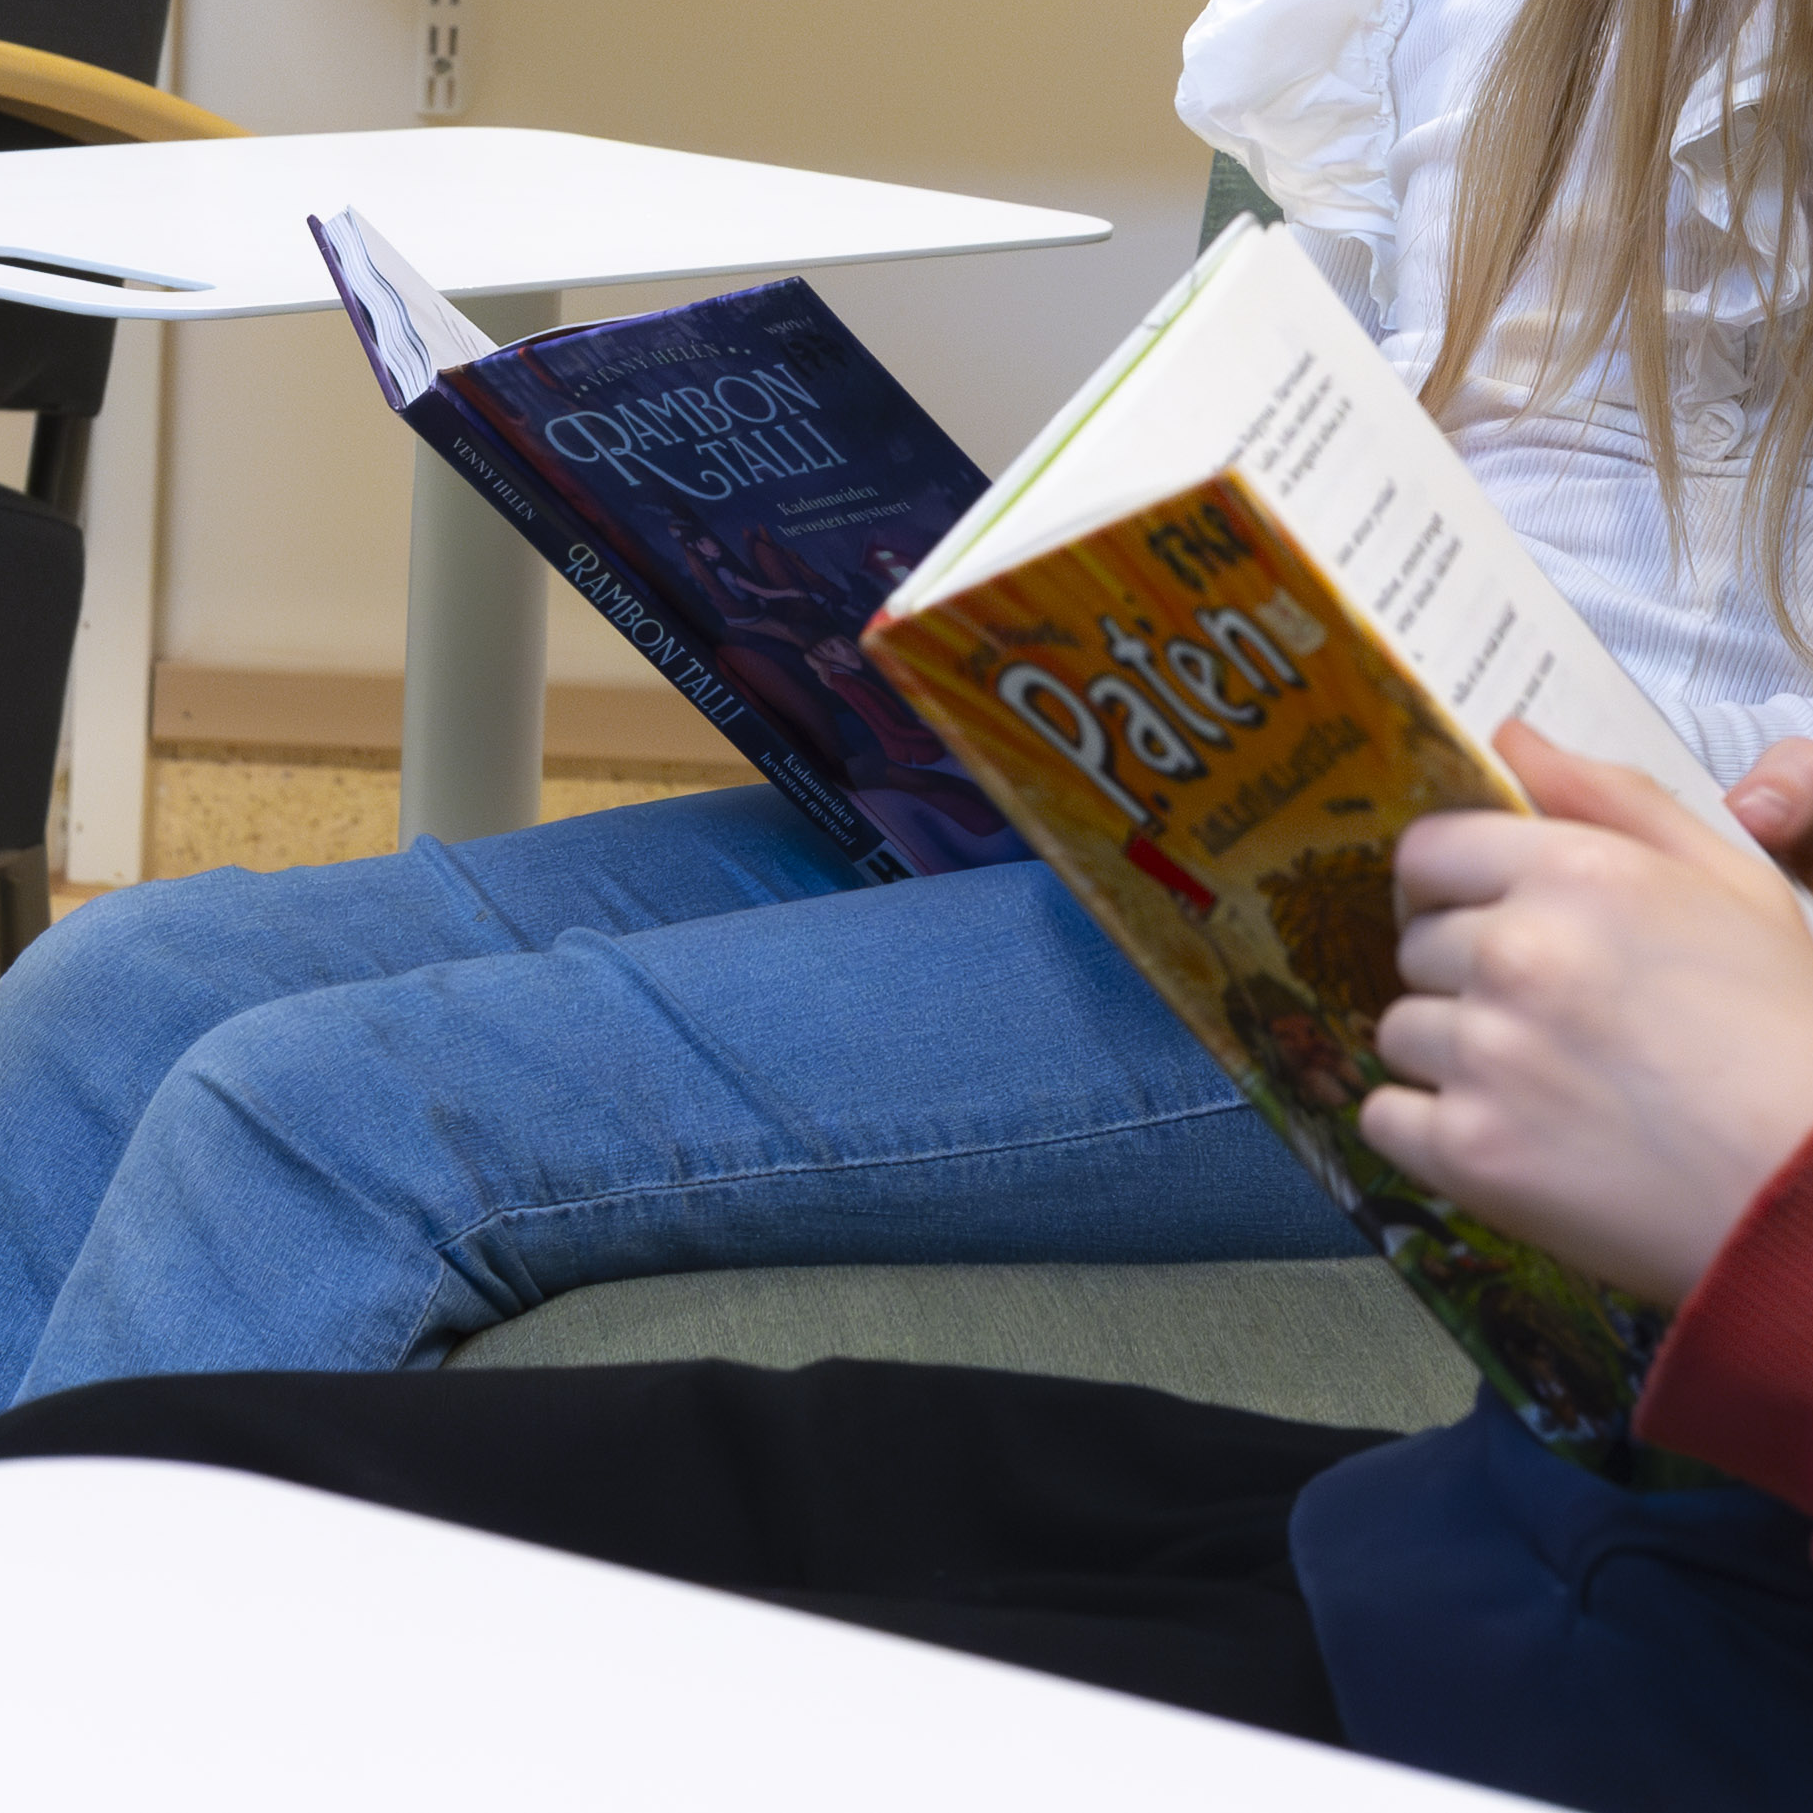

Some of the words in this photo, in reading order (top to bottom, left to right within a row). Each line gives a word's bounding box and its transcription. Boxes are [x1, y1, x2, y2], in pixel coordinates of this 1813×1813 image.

[586, 354, 648, 388] VENNY
[451, 436, 496, 480] VENNY
[544, 363, 820, 496] RAMBON
[695, 419, 848, 487] TALLI
[565, 542, 686, 667] RAMBON
[674, 656, 746, 726] TALLI
[995, 601, 1310, 833] Paten
